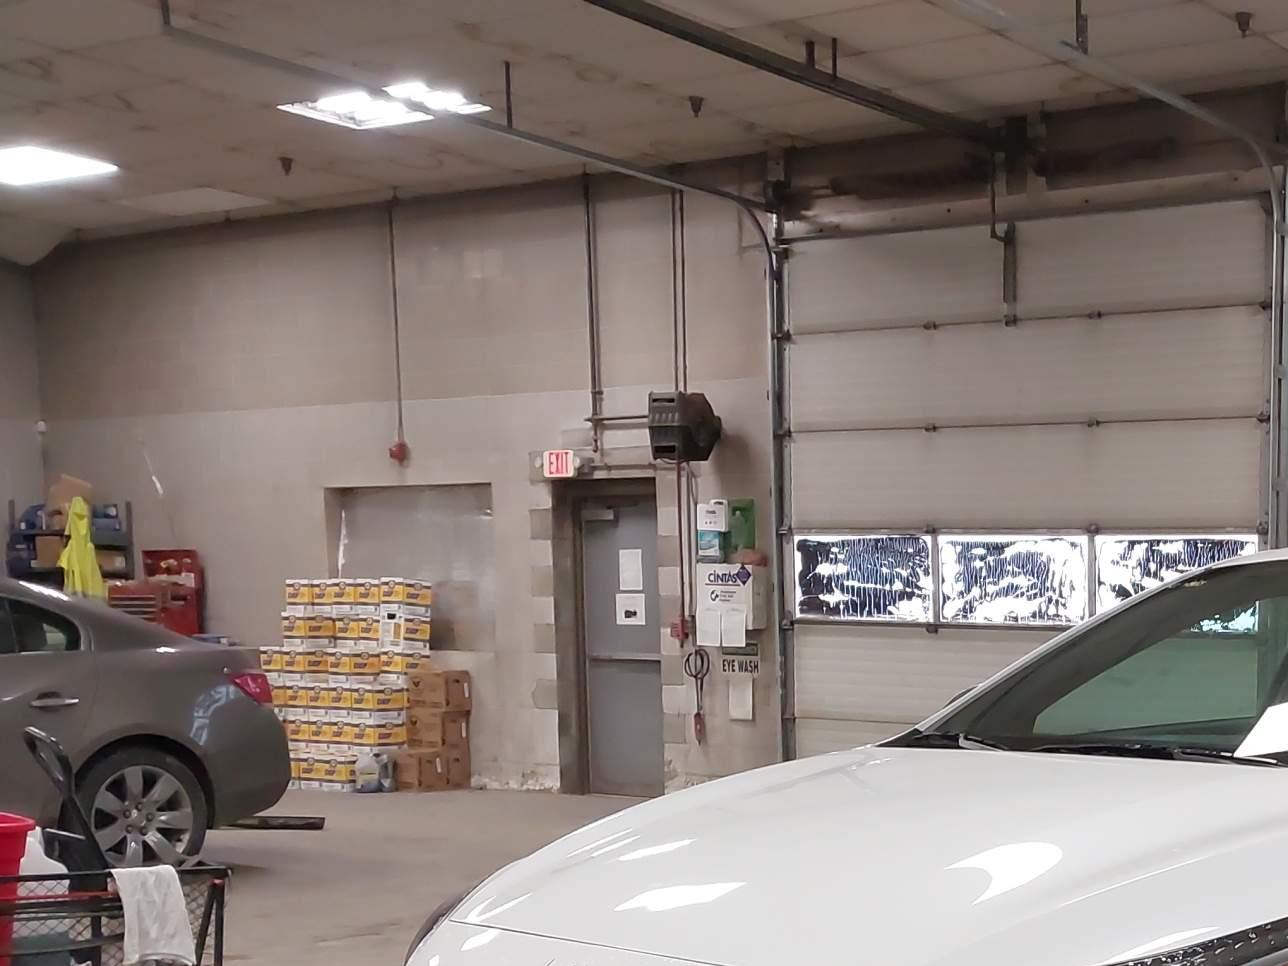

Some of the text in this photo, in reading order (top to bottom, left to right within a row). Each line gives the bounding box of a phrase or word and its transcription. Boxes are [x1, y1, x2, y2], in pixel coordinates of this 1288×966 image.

[549, 452, 569, 474] EXIT
[708, 569, 738, 583] CINTAS
[722, 659, 759, 673] EYE WASH
